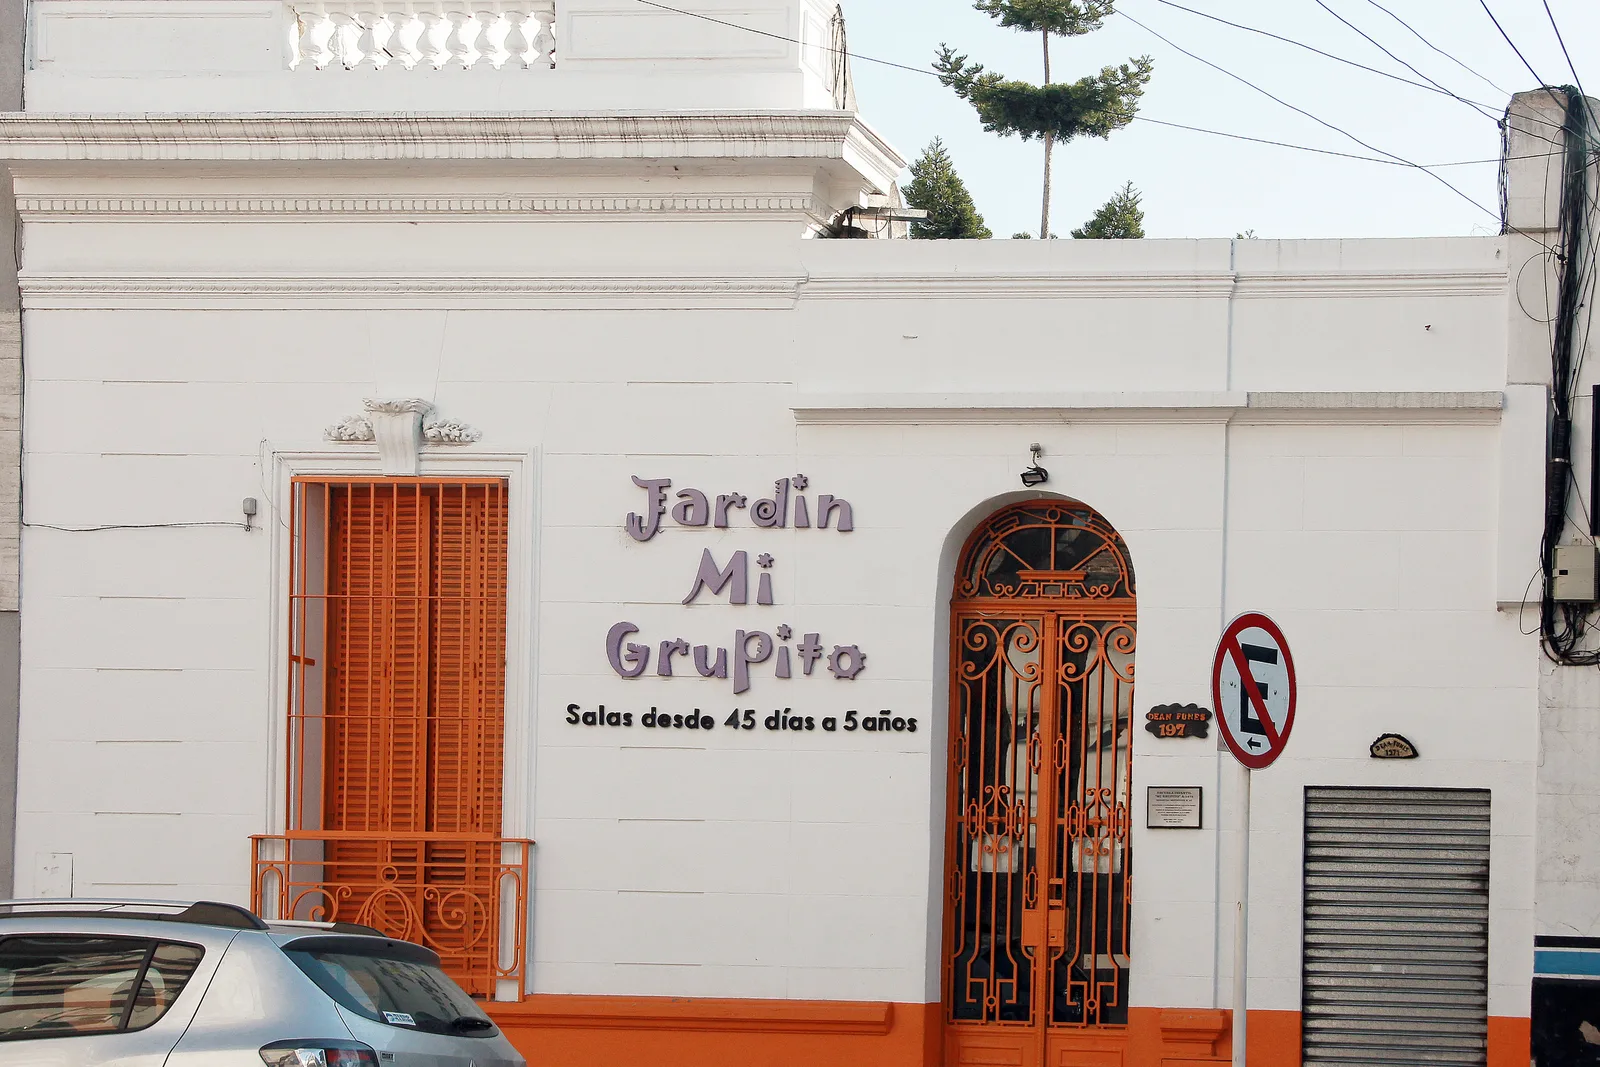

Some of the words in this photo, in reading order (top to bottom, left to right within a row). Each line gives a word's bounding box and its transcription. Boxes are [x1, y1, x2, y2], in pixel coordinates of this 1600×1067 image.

[625, 474, 854, 542] Jardin
[682, 547, 775, 606] Mi
[606, 621, 867, 695] Grupito
[565, 703, 633, 727] Salas
[641, 706, 715, 731] desde
[723, 708, 756, 731] 45
[764, 707, 816, 732] días
[821, 716, 837, 732] a
[843, 710, 859, 732] 5
[861, 709, 918, 733] años
[1148, 712, 1173, 721] DEAN
[1176, 712, 1206, 721] FUNES
[1240, 643, 1278, 735] E
[1159, 723, 1186, 737] 197
